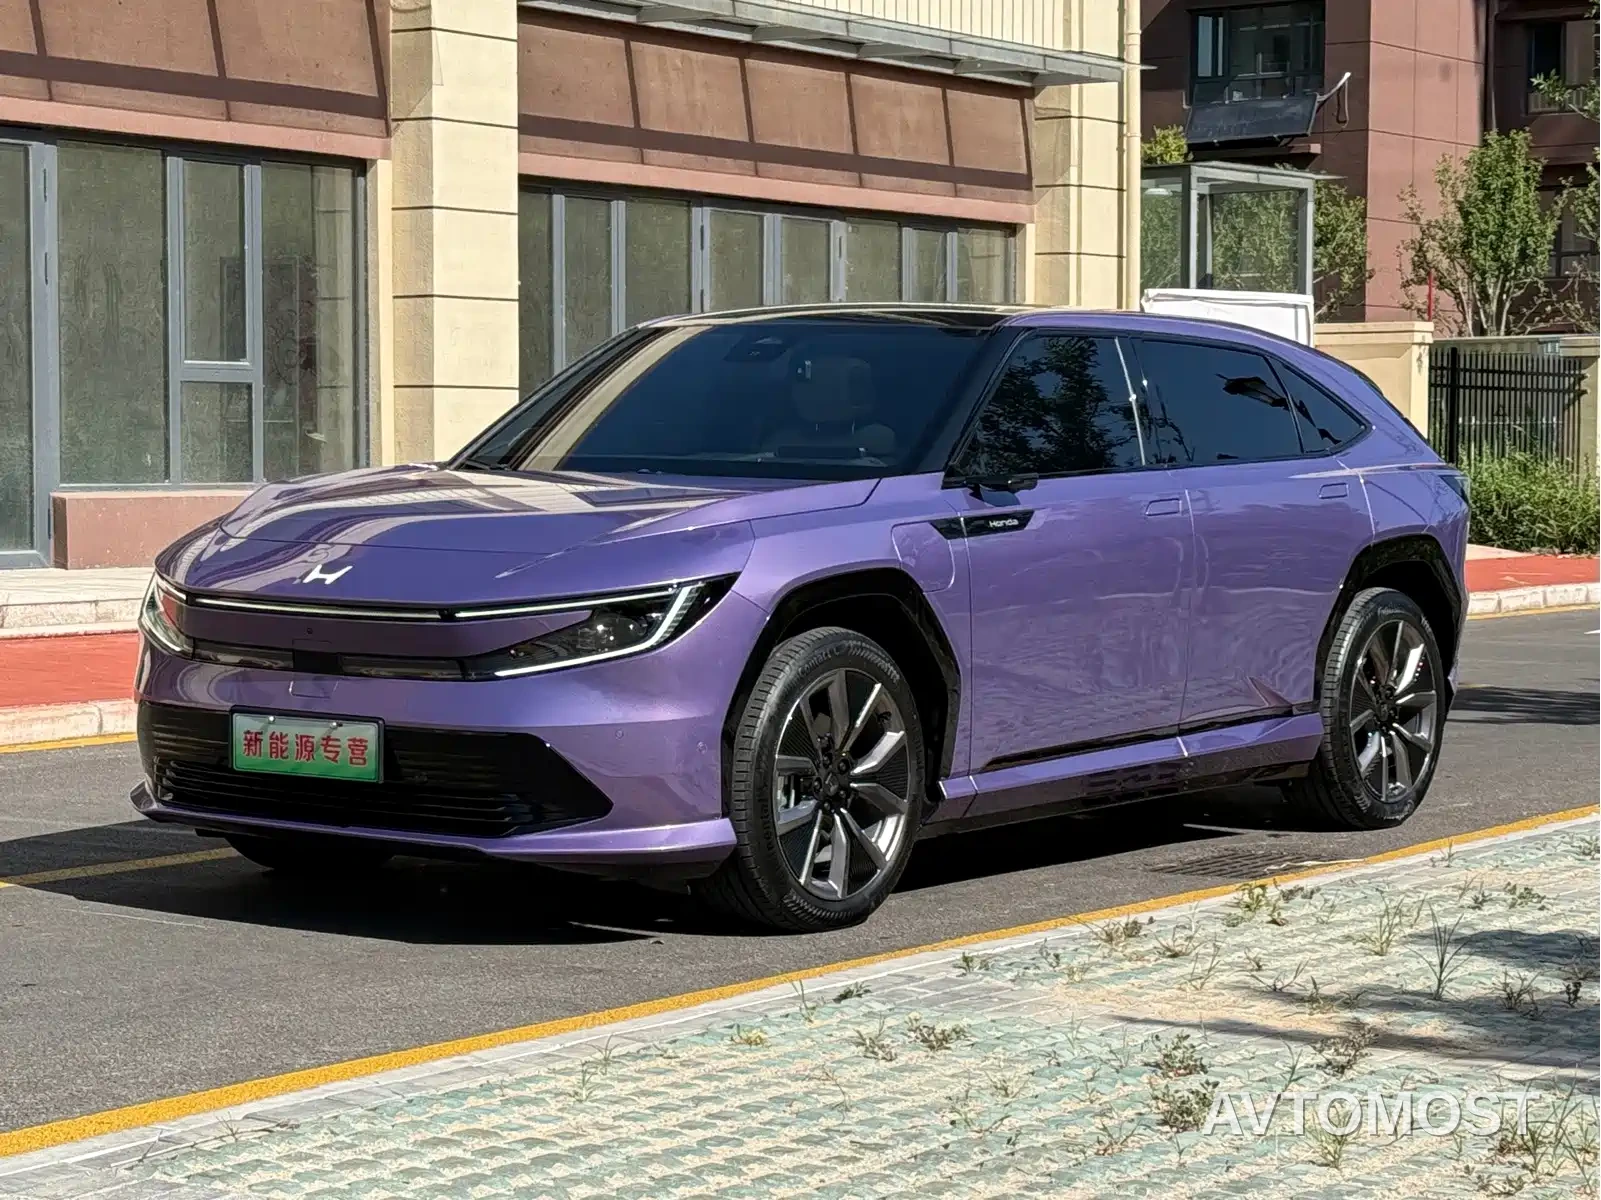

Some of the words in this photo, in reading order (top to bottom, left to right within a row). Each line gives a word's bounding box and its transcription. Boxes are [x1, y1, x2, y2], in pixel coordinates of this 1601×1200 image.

[989, 519, 1019, 527] Honda
[242, 730, 368, 766] 新能源专营
